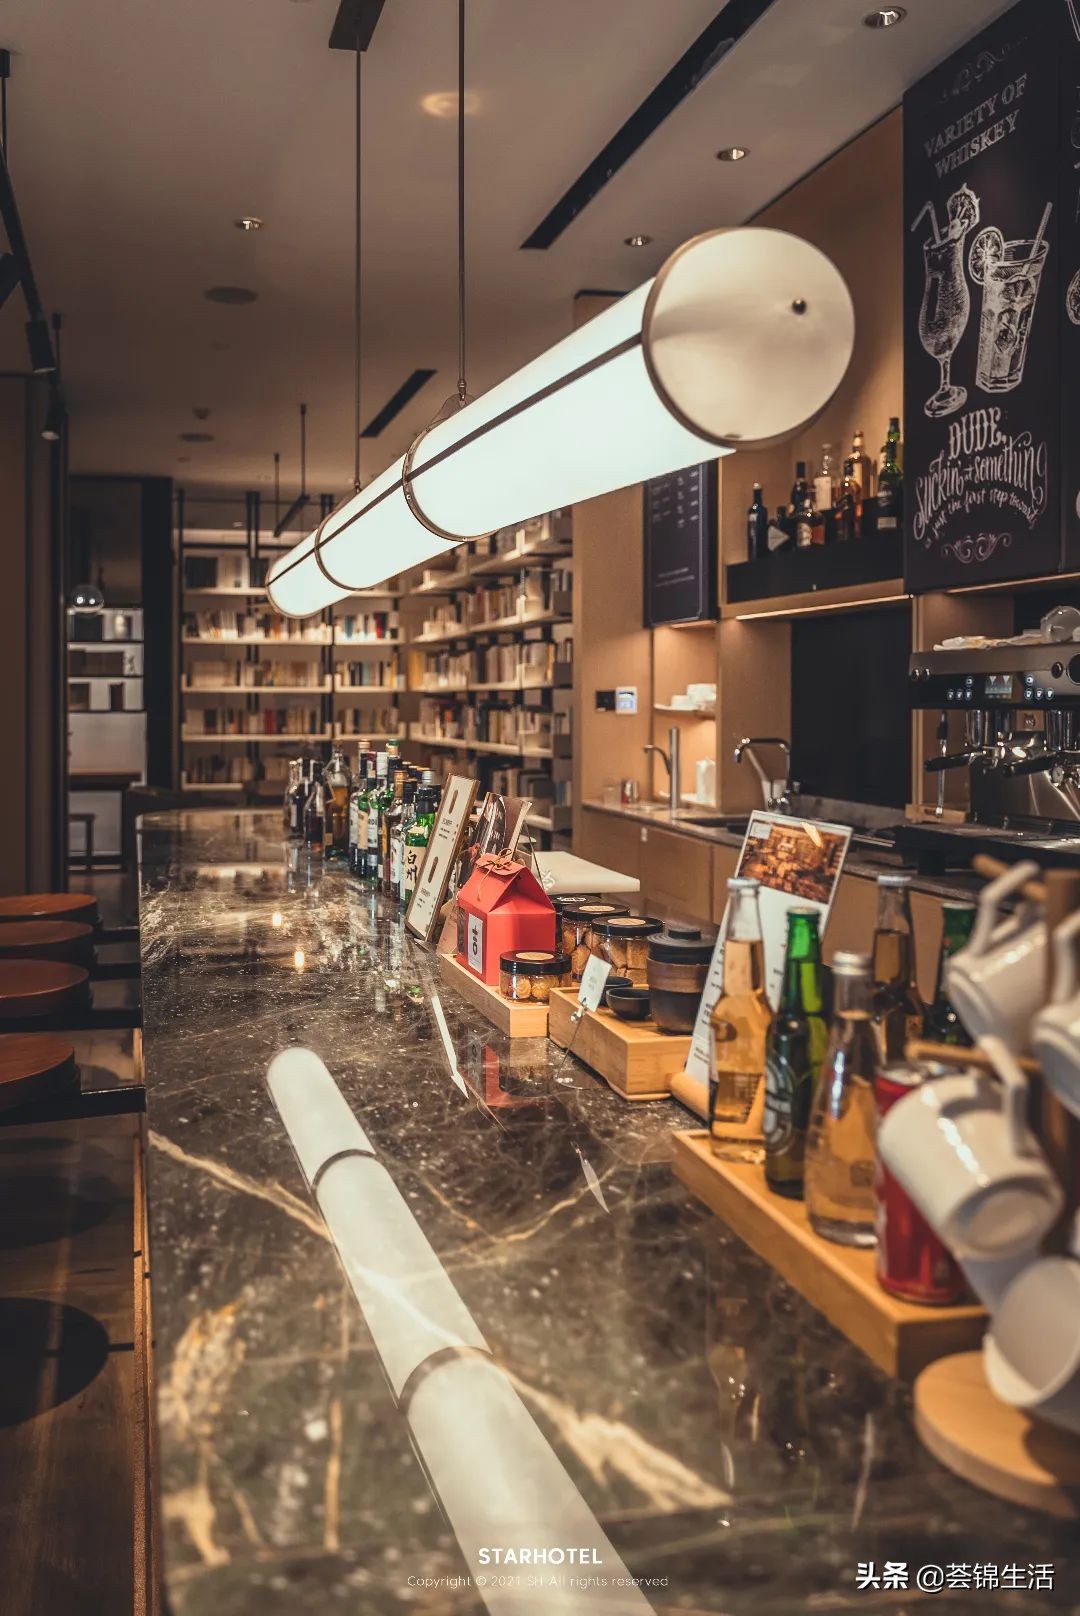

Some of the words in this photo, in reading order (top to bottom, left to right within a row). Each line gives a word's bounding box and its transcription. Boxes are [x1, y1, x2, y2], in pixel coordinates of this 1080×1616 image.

[923, 93, 999, 158] VARIETY
[1001, 72, 1028, 106] OF
[934, 109, 1020, 179] WHISKEY
[974, 431, 1048, 517] something
